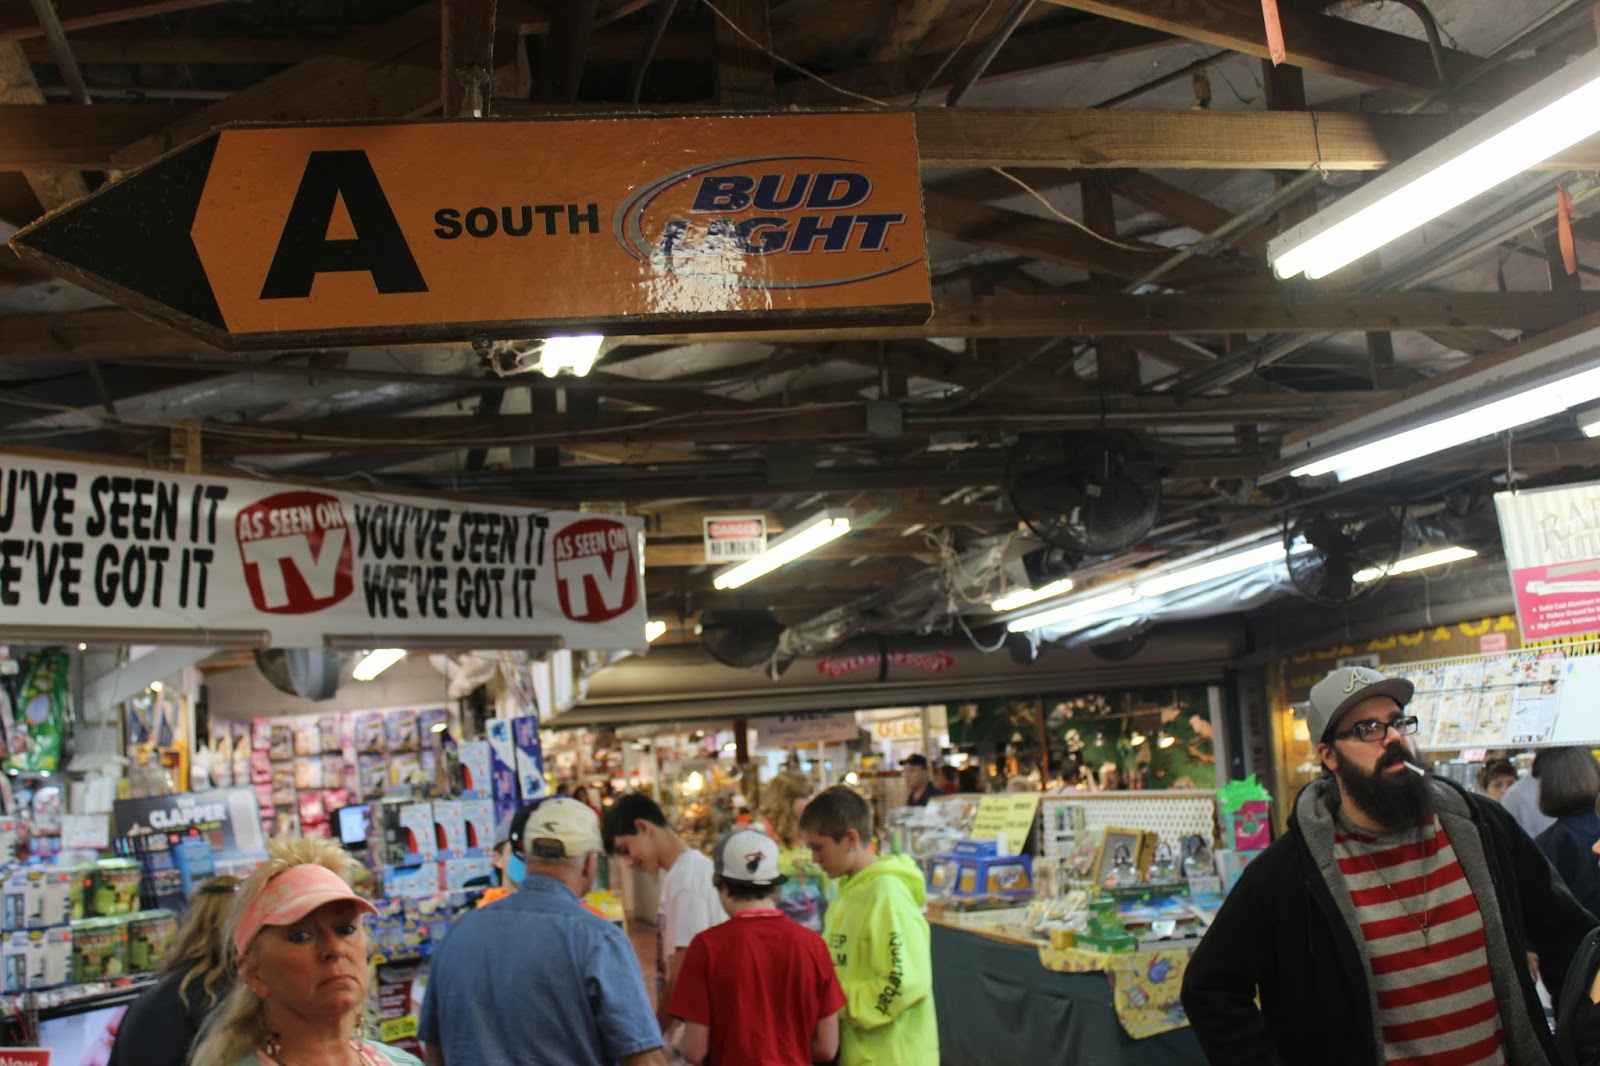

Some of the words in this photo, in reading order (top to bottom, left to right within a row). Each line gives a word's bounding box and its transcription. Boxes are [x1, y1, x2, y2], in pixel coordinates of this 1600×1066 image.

[690, 172, 873, 214] BUD
[259, 149, 429, 299] A
[433, 203, 600, 240] SOUTH
[653, 213, 906, 256] LIGHT
[86, 475, 179, 542] SEEN
[189, 483, 228, 545] IT
[238, 511, 265, 542] AS
[268, 505, 315, 537] SEEN
[315, 501, 345, 529] ON
[354, 502, 451, 562] YOU'VE
[452, 510, 519, 564] SEEN
[524, 513, 549, 566] IT
[241, 527, 347, 610] TV
[556, 537, 573, 560] AS
[574, 531, 606, 557] SEEN
[608, 526, 629, 551] ON
[94, 542, 170, 608] GOT
[179, 547, 214, 609] IT
[363, 562, 448, 619] WE'VE
[455, 566, 505, 619] GOT
[513, 568, 537, 619] IT
[557, 550, 630, 618] TV
[149, 803, 227, 829] CLAPPER
